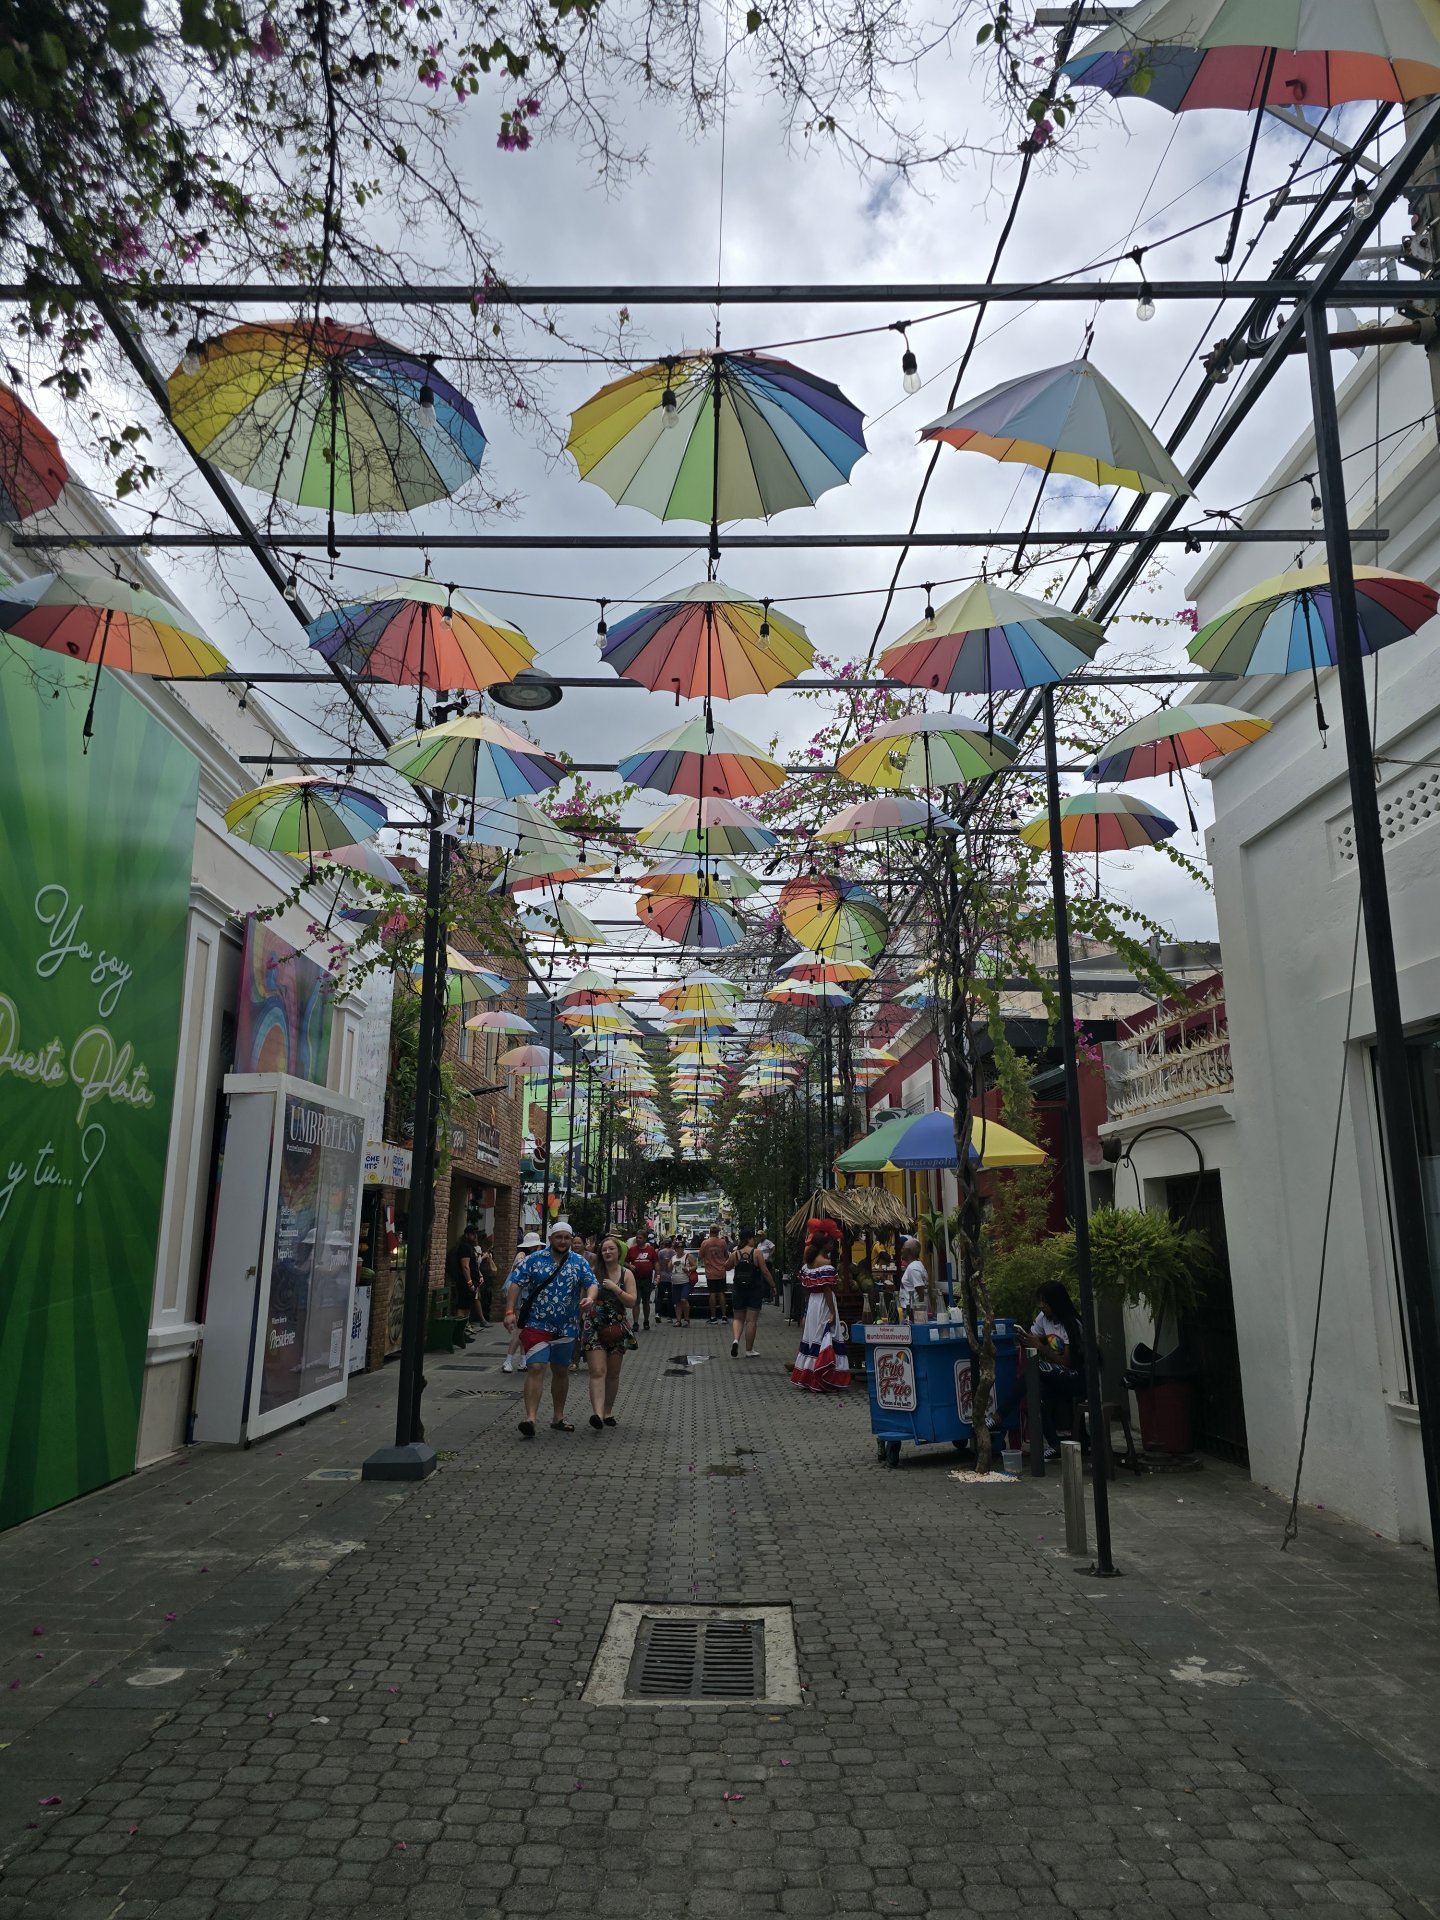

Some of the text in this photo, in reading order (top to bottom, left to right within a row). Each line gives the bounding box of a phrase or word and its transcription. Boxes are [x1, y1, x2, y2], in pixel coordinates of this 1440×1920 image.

[35, 884, 133, 1017] Yo soy
[70, 1028, 152, 1124] Plata
[291, 1106, 356, 1153] UMBRELLAS
